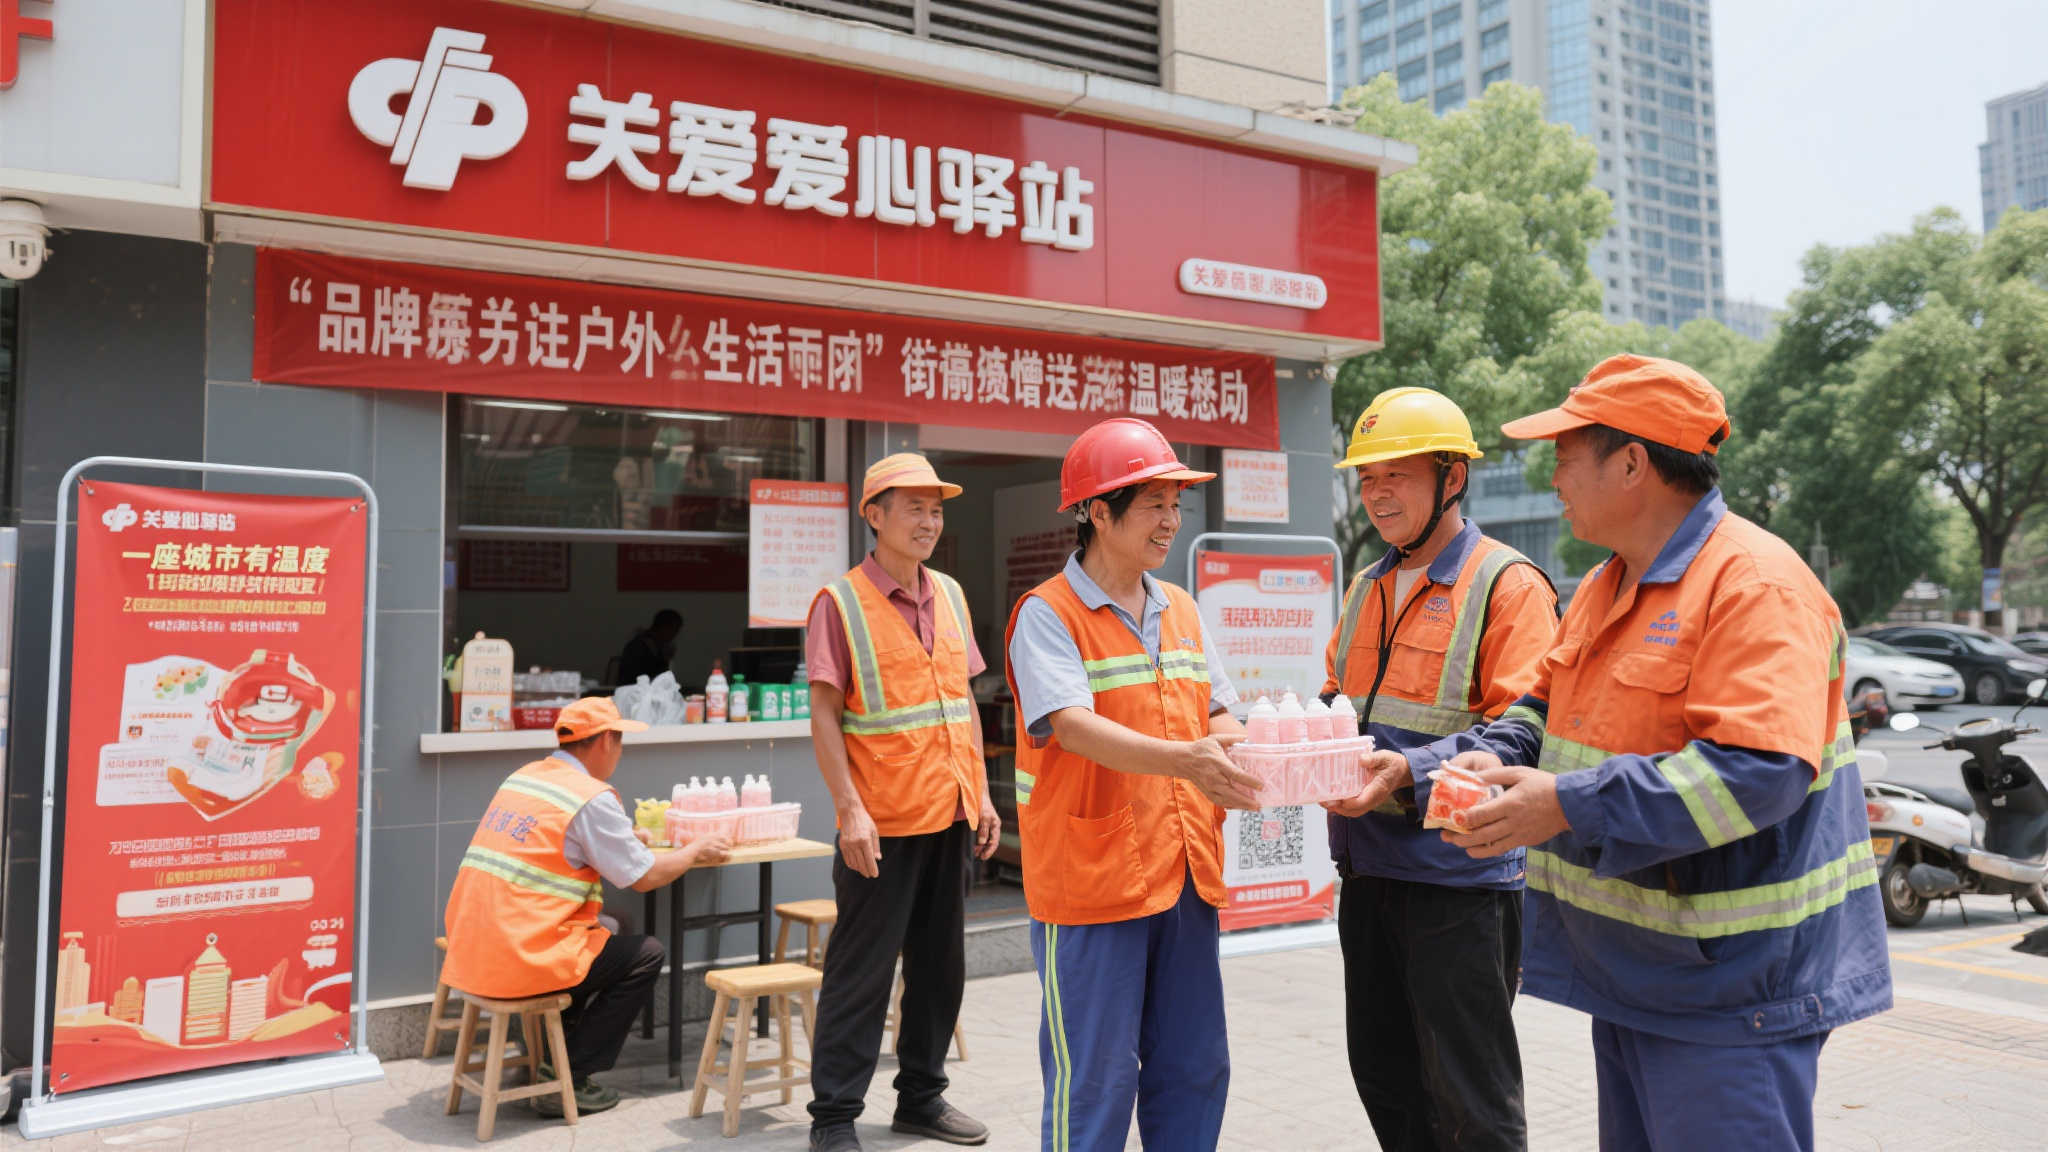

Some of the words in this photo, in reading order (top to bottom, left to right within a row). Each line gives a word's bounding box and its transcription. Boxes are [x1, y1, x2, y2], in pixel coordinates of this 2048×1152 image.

[566, 83, 1095, 251] 关爱爱心驿站
[122, 542, 331, 575] 一座城市有温度
